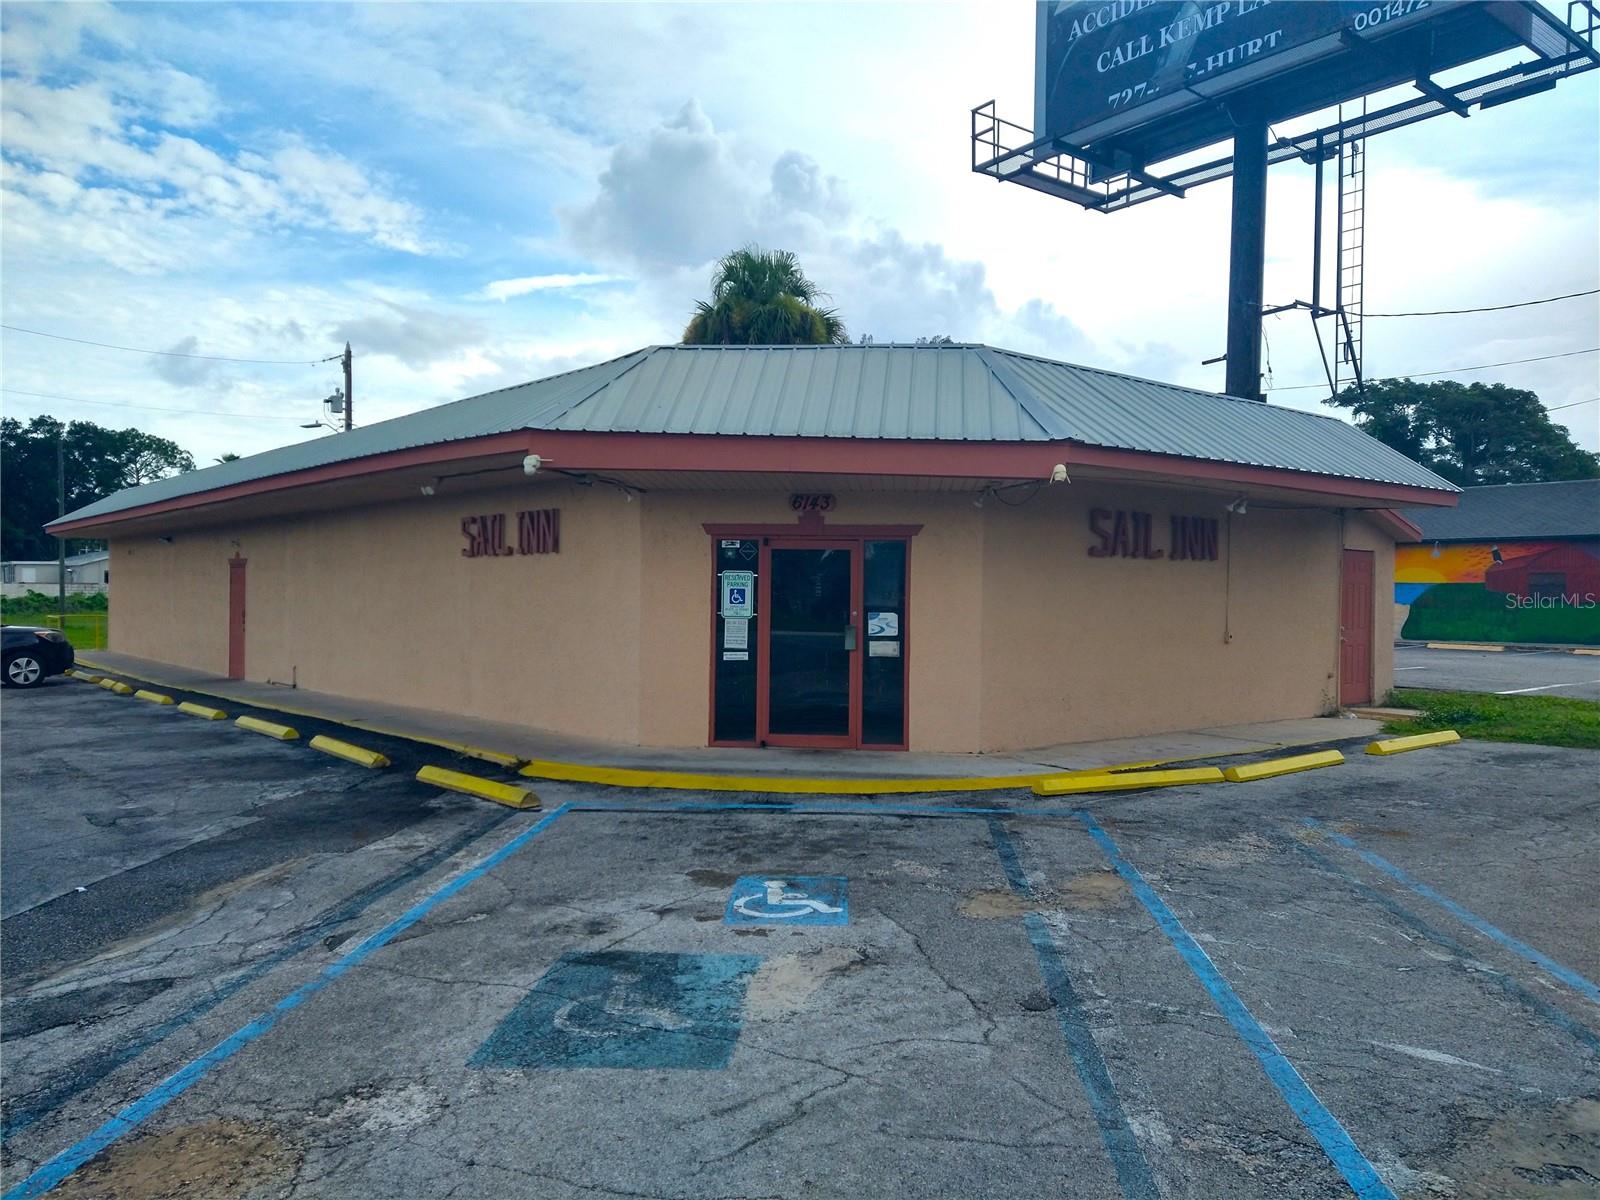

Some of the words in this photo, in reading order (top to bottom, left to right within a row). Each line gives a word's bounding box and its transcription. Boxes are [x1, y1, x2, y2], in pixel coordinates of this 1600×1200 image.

[1067, 0, 1157, 42] ACCIDE
[1096, 34, 1154, 73] CALL
[1158, 1, 1231, 48] KEMP
[792, 495, 831, 510] 6143
[461, 513, 514, 558] SAIL
[516, 508, 560, 556] INN
[1087, 507, 1164, 560] SAIL
[1168, 514, 1219, 562] INN
[724, 574, 751, 582] RESERVED
